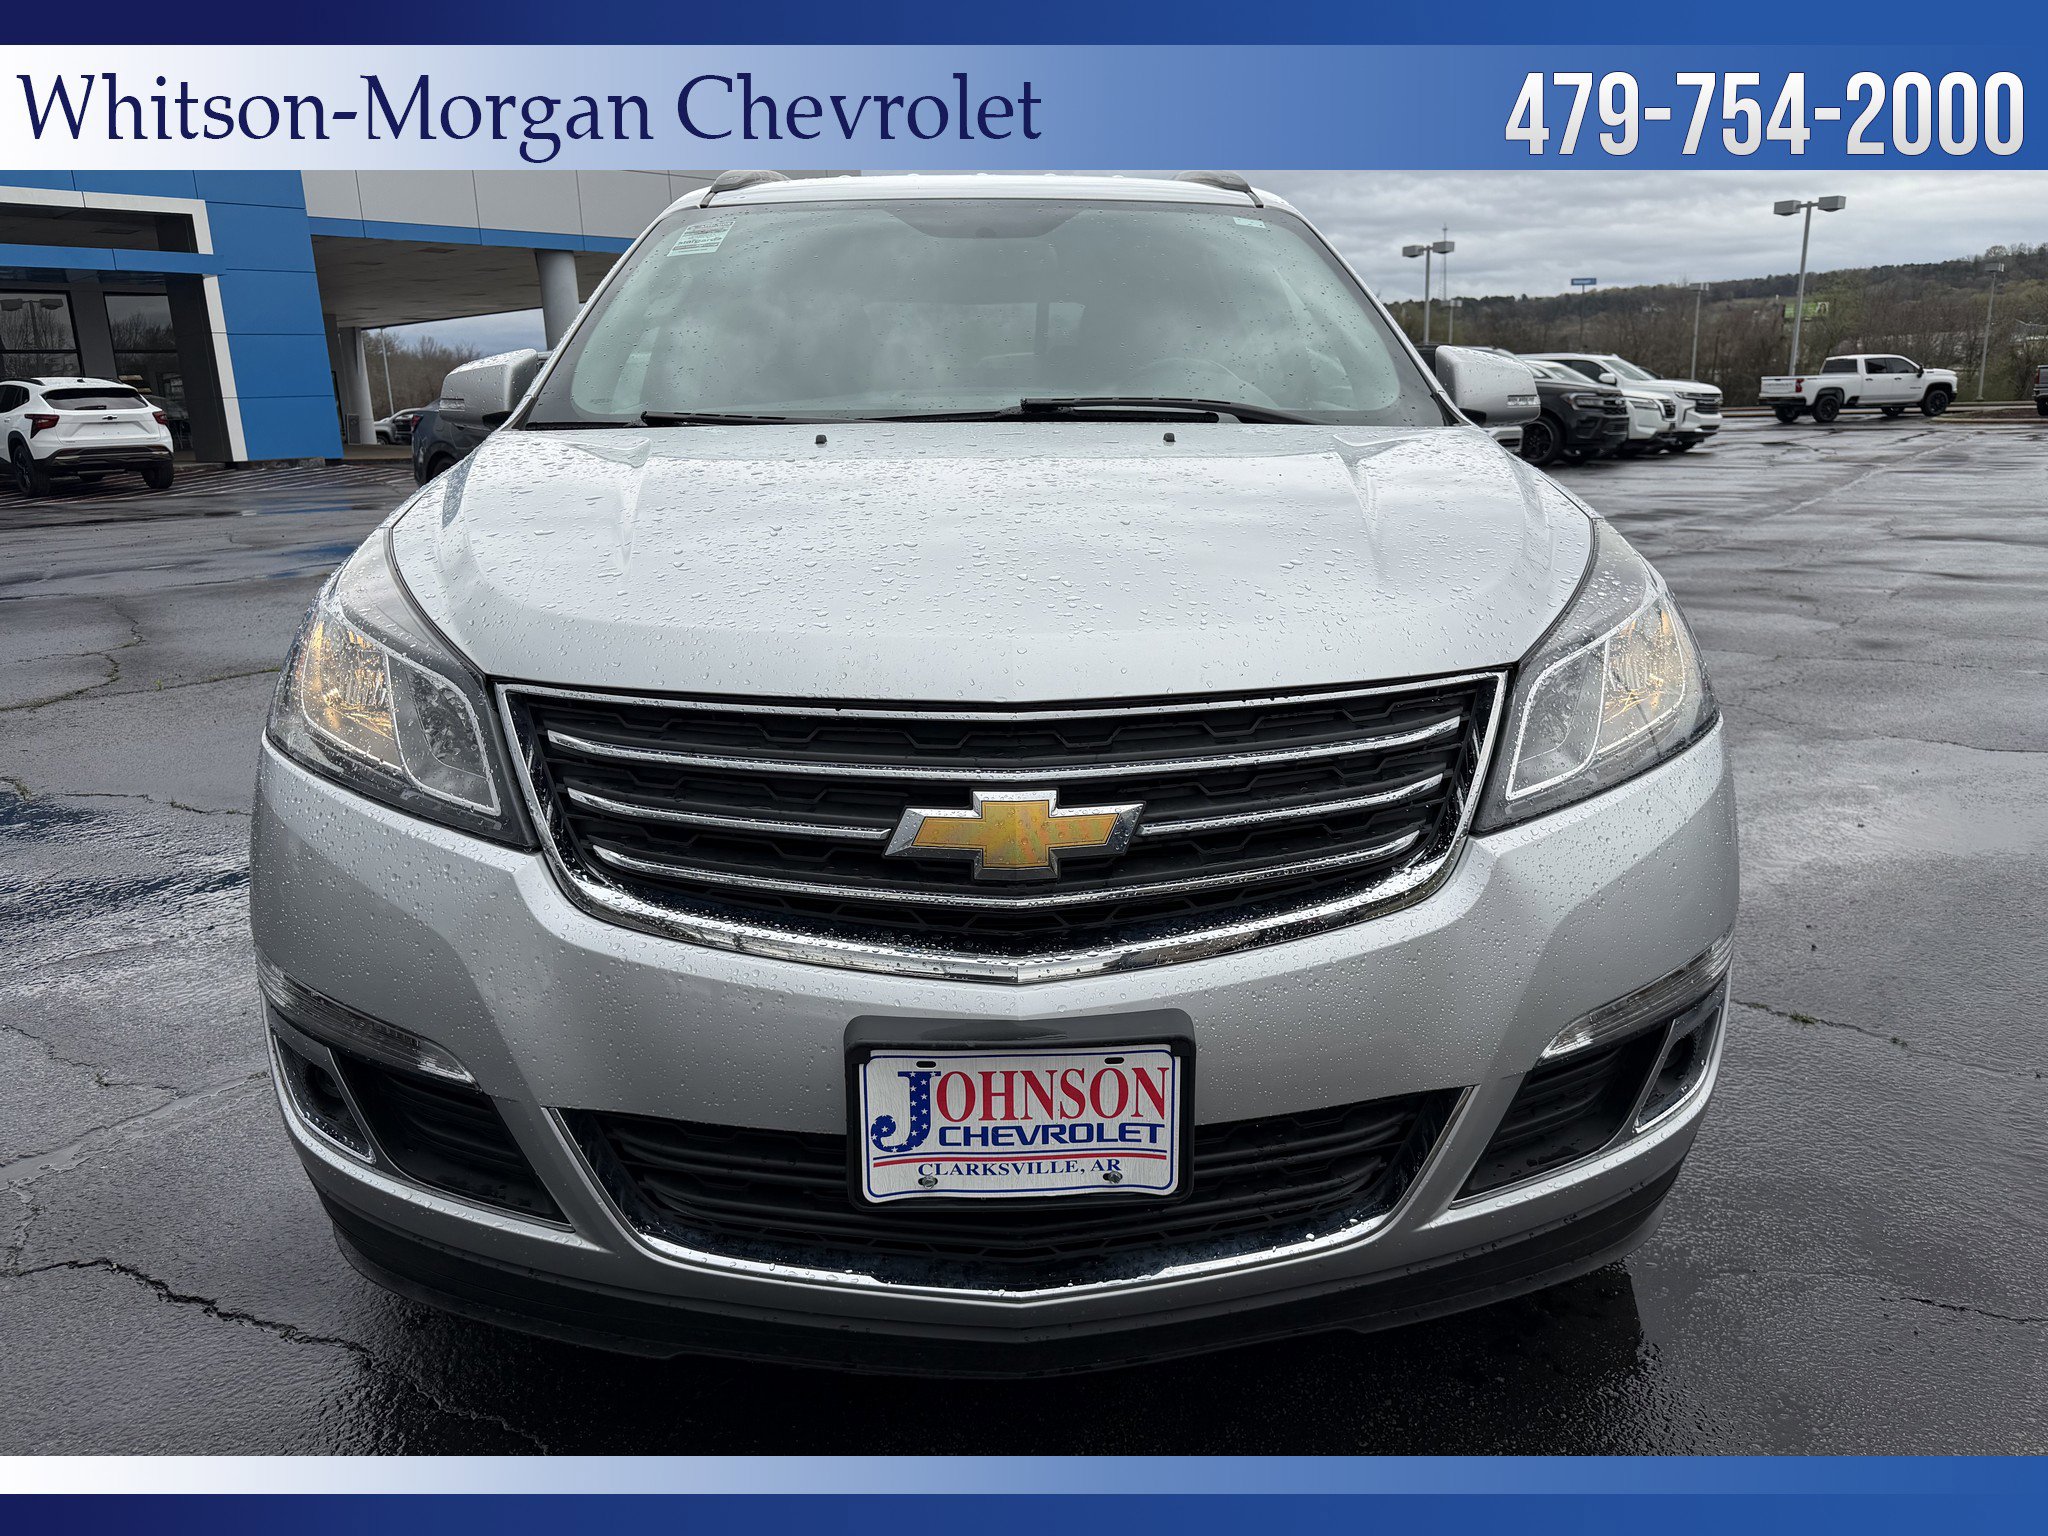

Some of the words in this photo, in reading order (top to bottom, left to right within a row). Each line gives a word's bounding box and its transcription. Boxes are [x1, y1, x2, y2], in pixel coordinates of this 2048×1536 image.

[870, 1067, 1170, 1153] JOHNSON
[938, 1122, 1166, 1147] CHEVROLET
[917, 1160, 1086, 1177] CLARKSVILLE,
[1090, 1158, 1122, 1173] AR
